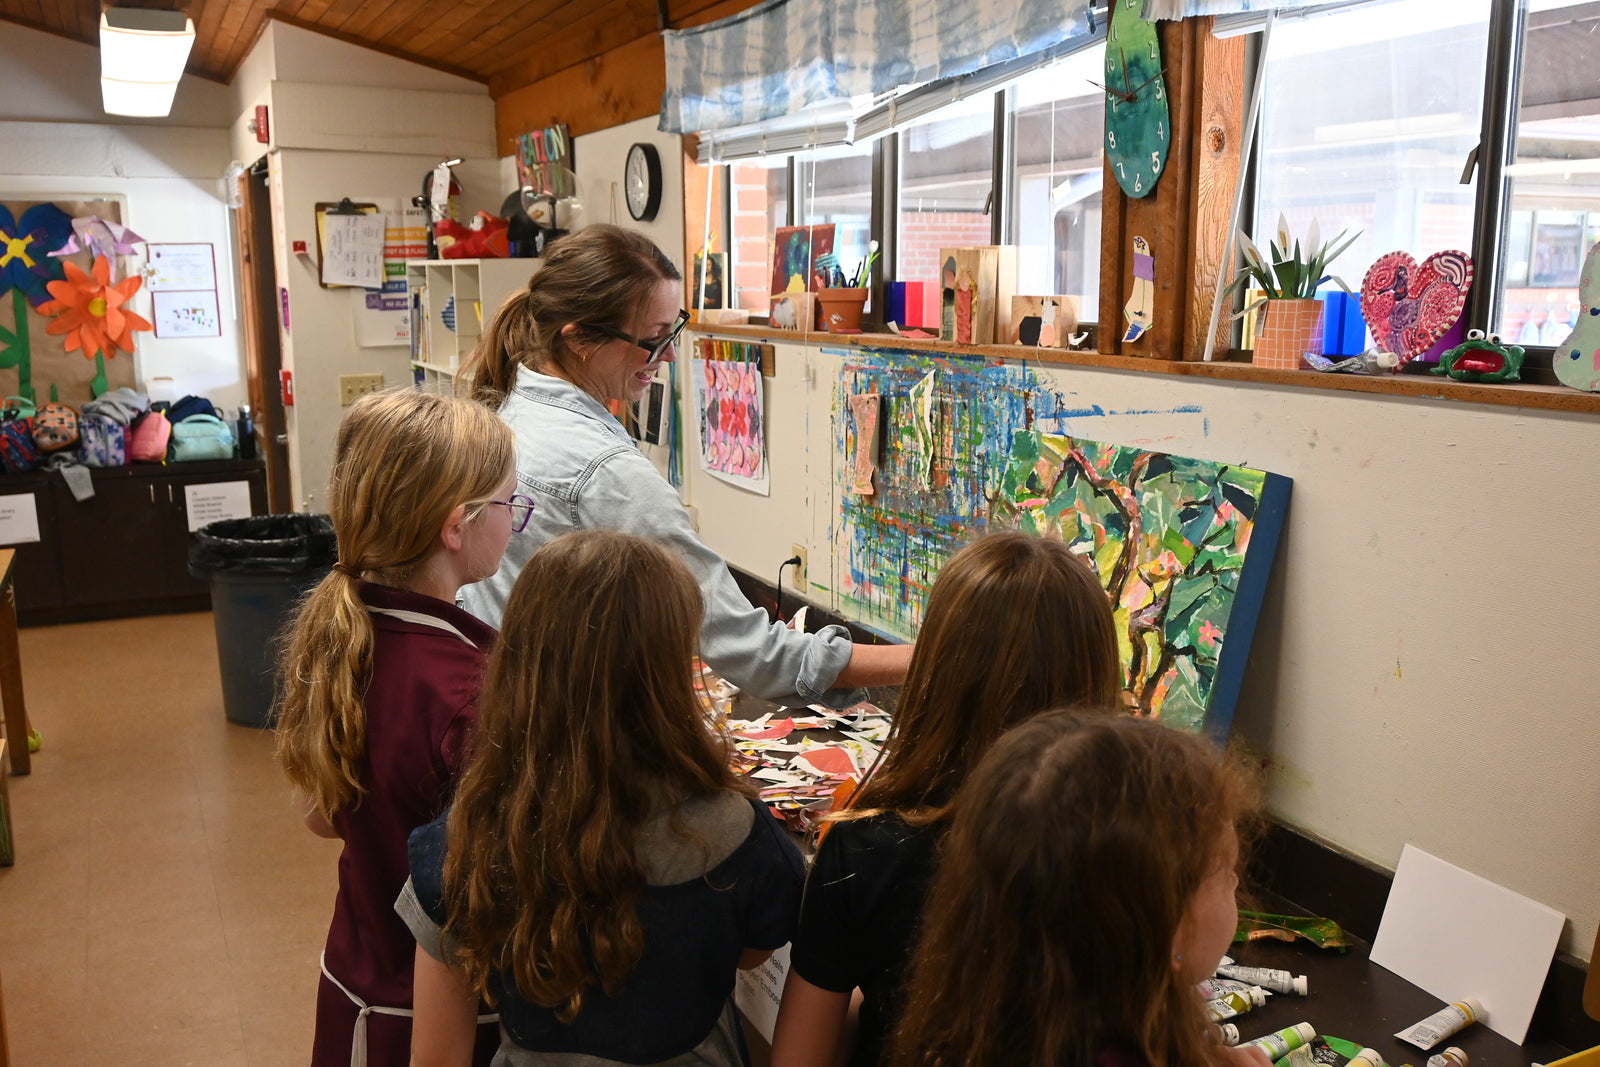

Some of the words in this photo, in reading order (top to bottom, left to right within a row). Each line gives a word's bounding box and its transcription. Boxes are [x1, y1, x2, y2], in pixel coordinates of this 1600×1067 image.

[1111, 25, 1118, 42] 11
[1148, 40, 1157, 59] 2
[1105, 57, 1116, 73] 10
[1154, 79, 1162, 100] 3
[1108, 131, 1116, 149] 8
[1156, 121, 1165, 141] 4
[1116, 162, 1126, 180] 7
[1151, 151, 1161, 174] 5
[1134, 173, 1142, 193] 6
